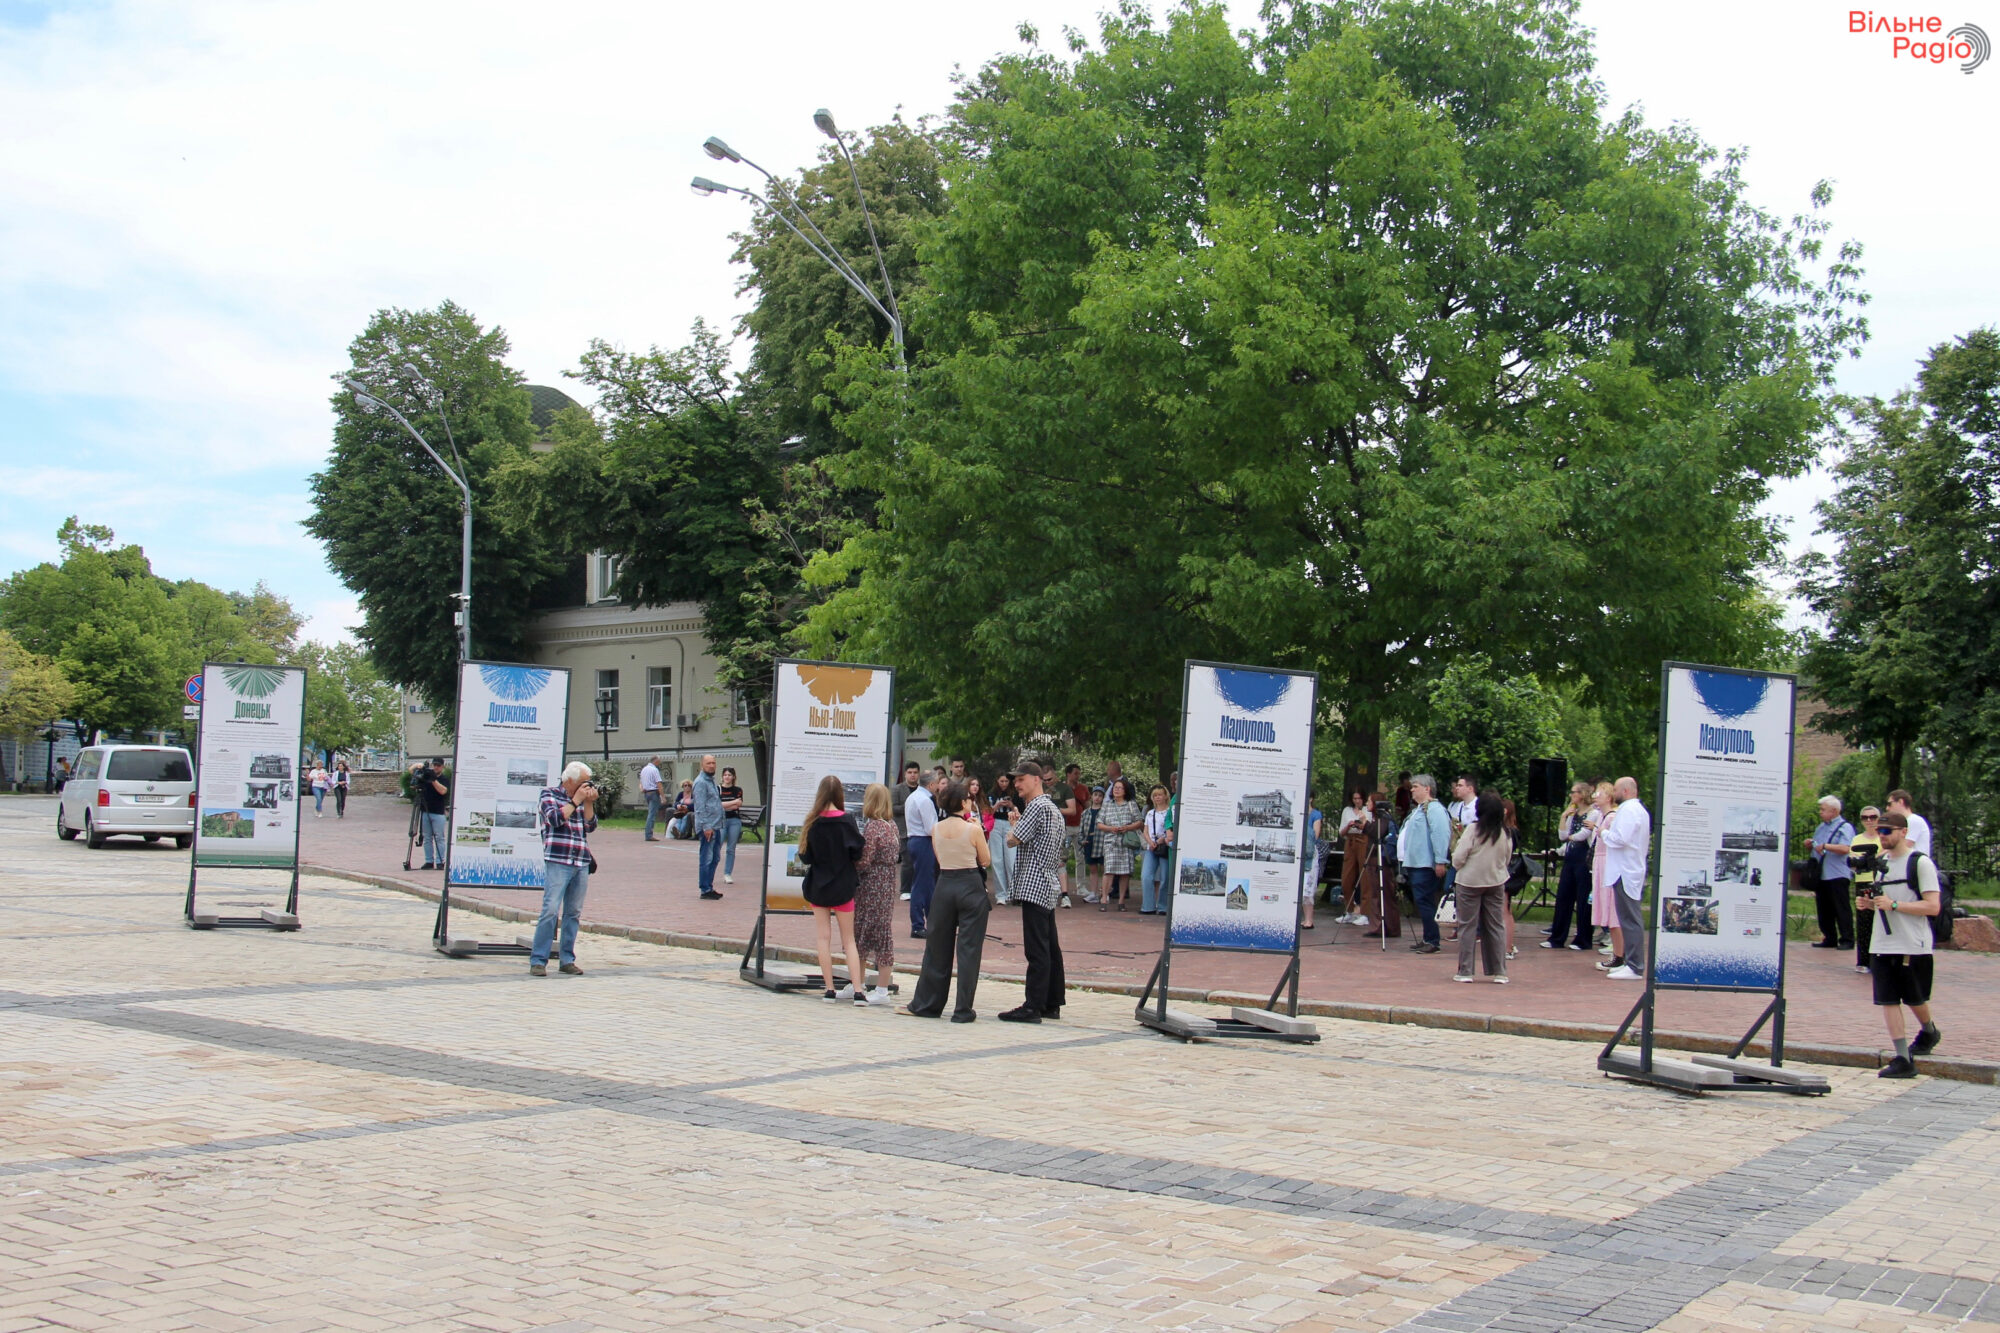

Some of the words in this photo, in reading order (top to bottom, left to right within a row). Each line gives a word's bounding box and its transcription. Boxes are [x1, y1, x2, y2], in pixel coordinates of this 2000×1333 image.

[234, 700, 271, 720] Донецьк
[488, 701, 537, 724] Дружківка
[808, 705, 856, 731] Нью-Йорк
[1219, 715, 1276, 744] Маріуполь
[1699, 723, 1755, 755] Маріуполь
